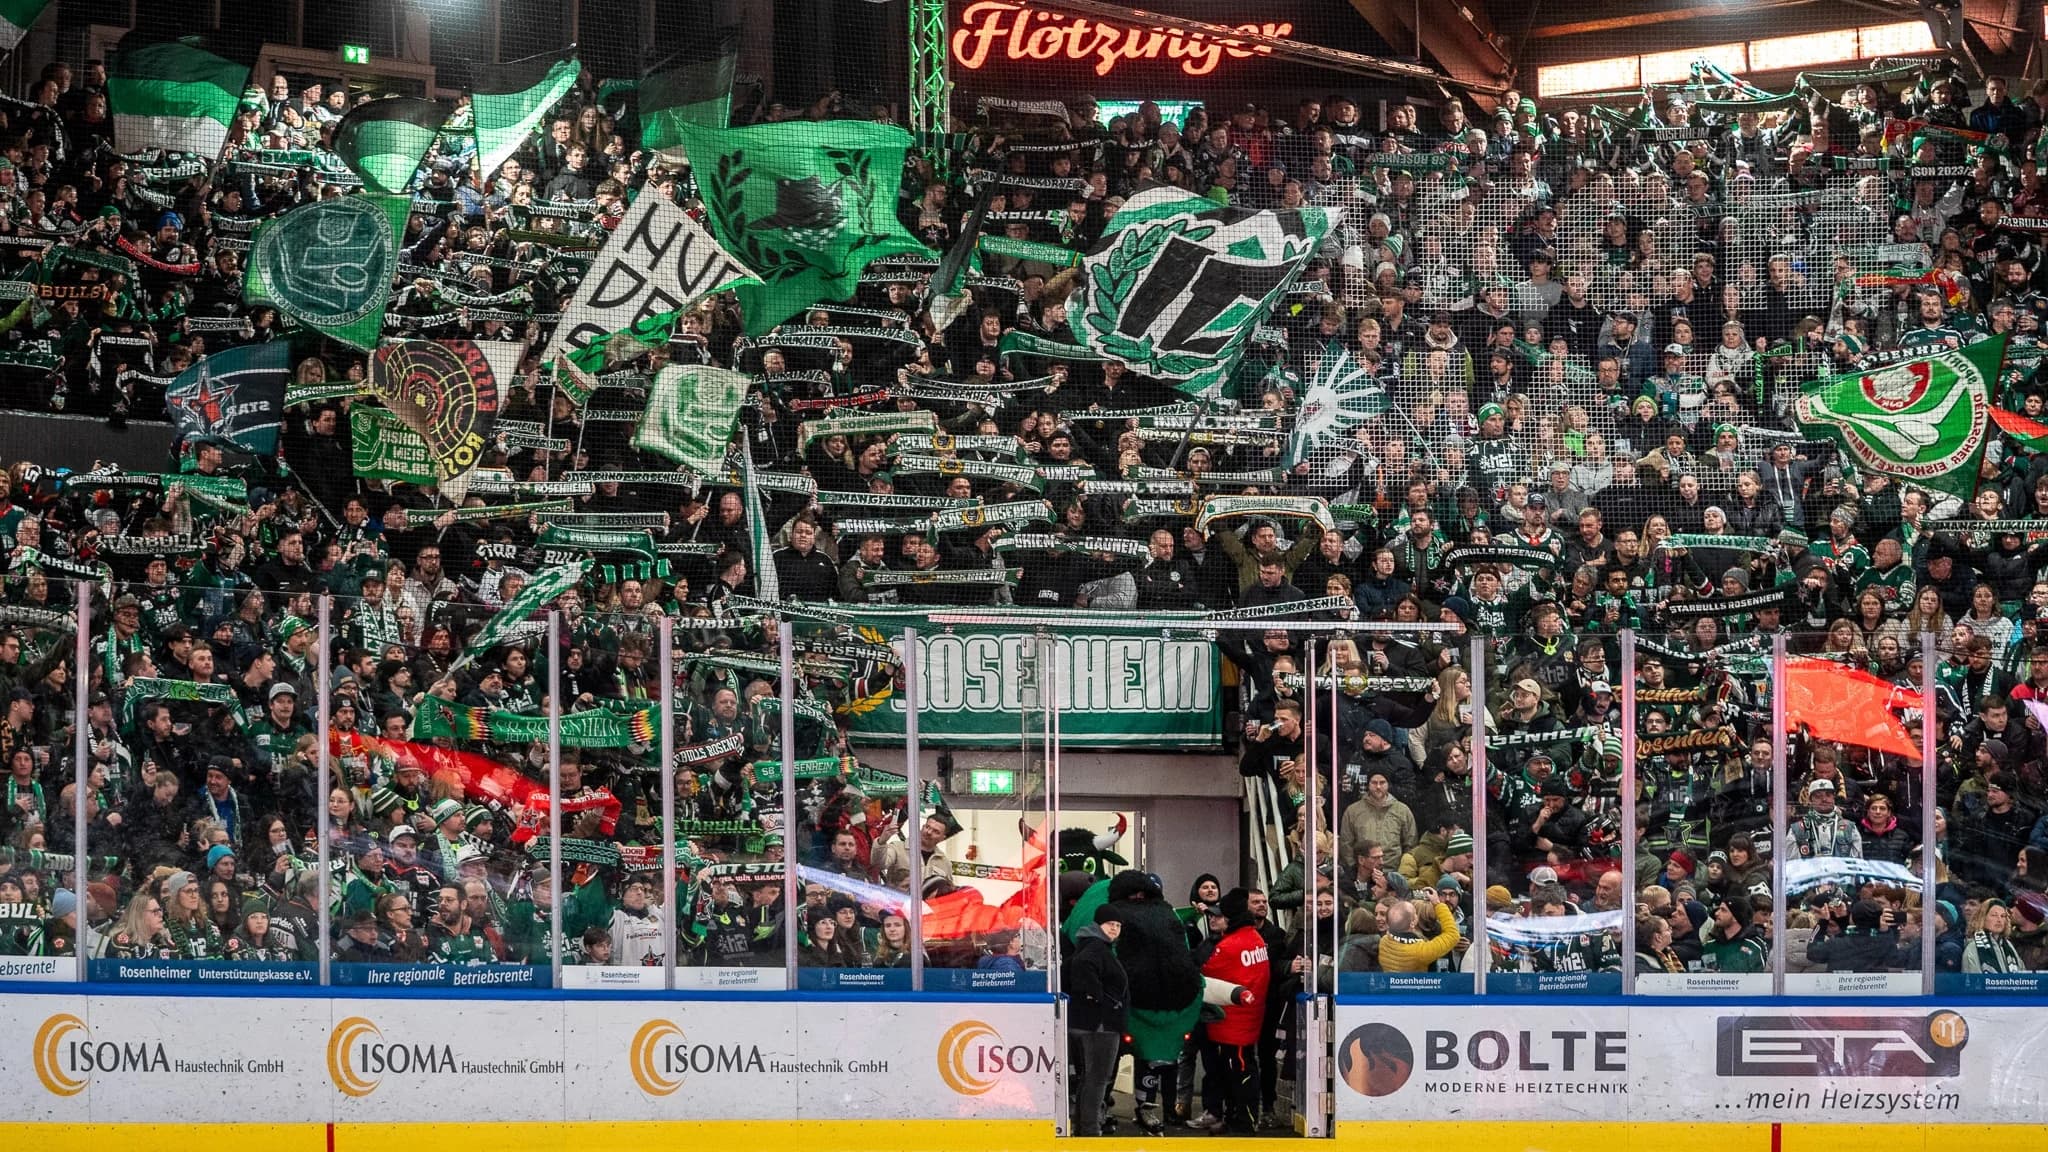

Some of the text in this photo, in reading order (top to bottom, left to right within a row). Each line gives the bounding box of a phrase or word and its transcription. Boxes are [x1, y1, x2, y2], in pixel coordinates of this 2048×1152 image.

[952, 1, 1293, 75] Flötzinger
[40, 284, 103, 300] BULLS
[816, 418, 909, 433] SB ROSENHEIM
[1445, 549, 1556, 577] STARBULLS ROSENHEIM
[1669, 592, 1785, 614] STARBULLS ROSENHEIM
[811, 644, 903, 669] ROSENHEIM
[526, 718, 622, 738] ROENHEIM
[0, 962, 56, 979] ebsrente!
[120, 965, 314, 984] Rosenheimer Unterstützungskasse e.V.
[368, 966, 534, 986] Ihre regionale Betriebsrente!
[601, 971, 640, 980] Rosenheimer
[732, 970, 758, 979] regionale
[839, 973, 885, 981] Rosenheimer
[972, 970, 1015, 980] Ihre regionale
[719, 977, 759, 986] Betriebsrente!
[972, 978, 1015, 988] Betriebsrente!
[1390, 977, 1442, 986] Rosenheimer
[1538, 974, 1588, 985] Ihre regionale
[1538, 982, 1589, 991] Betriebsrente!
[1686, 978, 1740, 987] Rosenheimer
[1838, 974, 1887, 986] Ihre regionale
[1985, 977, 2039, 986] Rosenheimer
[1838, 982, 1888, 992] Betriebsrente!
[1425, 1030, 1627, 1071] BOLTE
[1741, 1030, 1936, 1064] ETA
[70, 1041, 172, 1073] ISOMA
[361, 1043, 457, 1074] ISOMA
[664, 1045, 766, 1074] ISOMA
[175, 1059, 285, 1073] Haustechnik GmbH
[461, 1060, 565, 1074] Haustechnik GmbH
[770, 1060, 889, 1073] Haustechnik GmbH
[1425, 1082, 1628, 1094] MODERNE HEIZTECHNIK
[1821, 1087, 1960, 1116] Heizsystem
